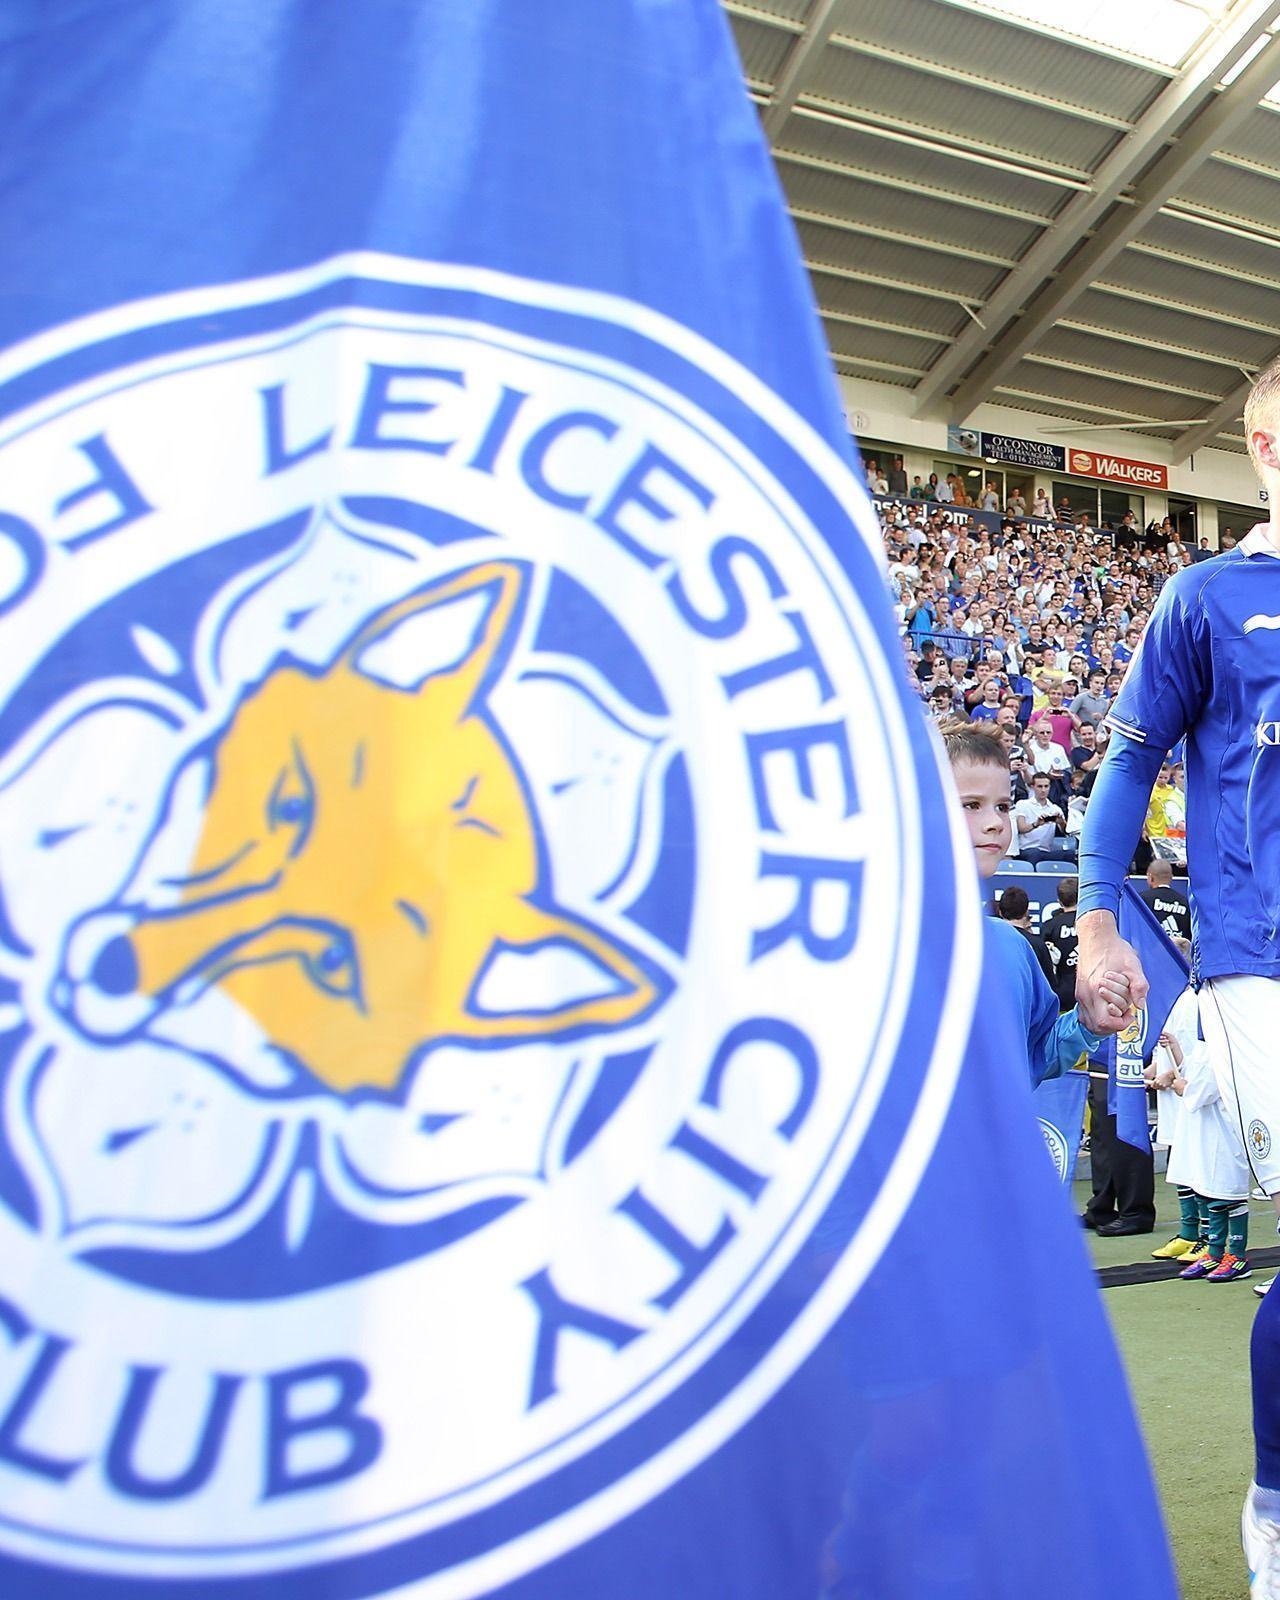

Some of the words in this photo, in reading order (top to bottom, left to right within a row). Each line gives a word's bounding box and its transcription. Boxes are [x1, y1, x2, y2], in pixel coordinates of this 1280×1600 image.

[992, 436, 1054, 456] O'CONNOR
[1095, 457, 1162, 484] WALKERS
[259, 362, 866, 968] LEICESTER
[1153, 898, 1187, 915] bwin
[515, 1014, 821, 1415] CITY
